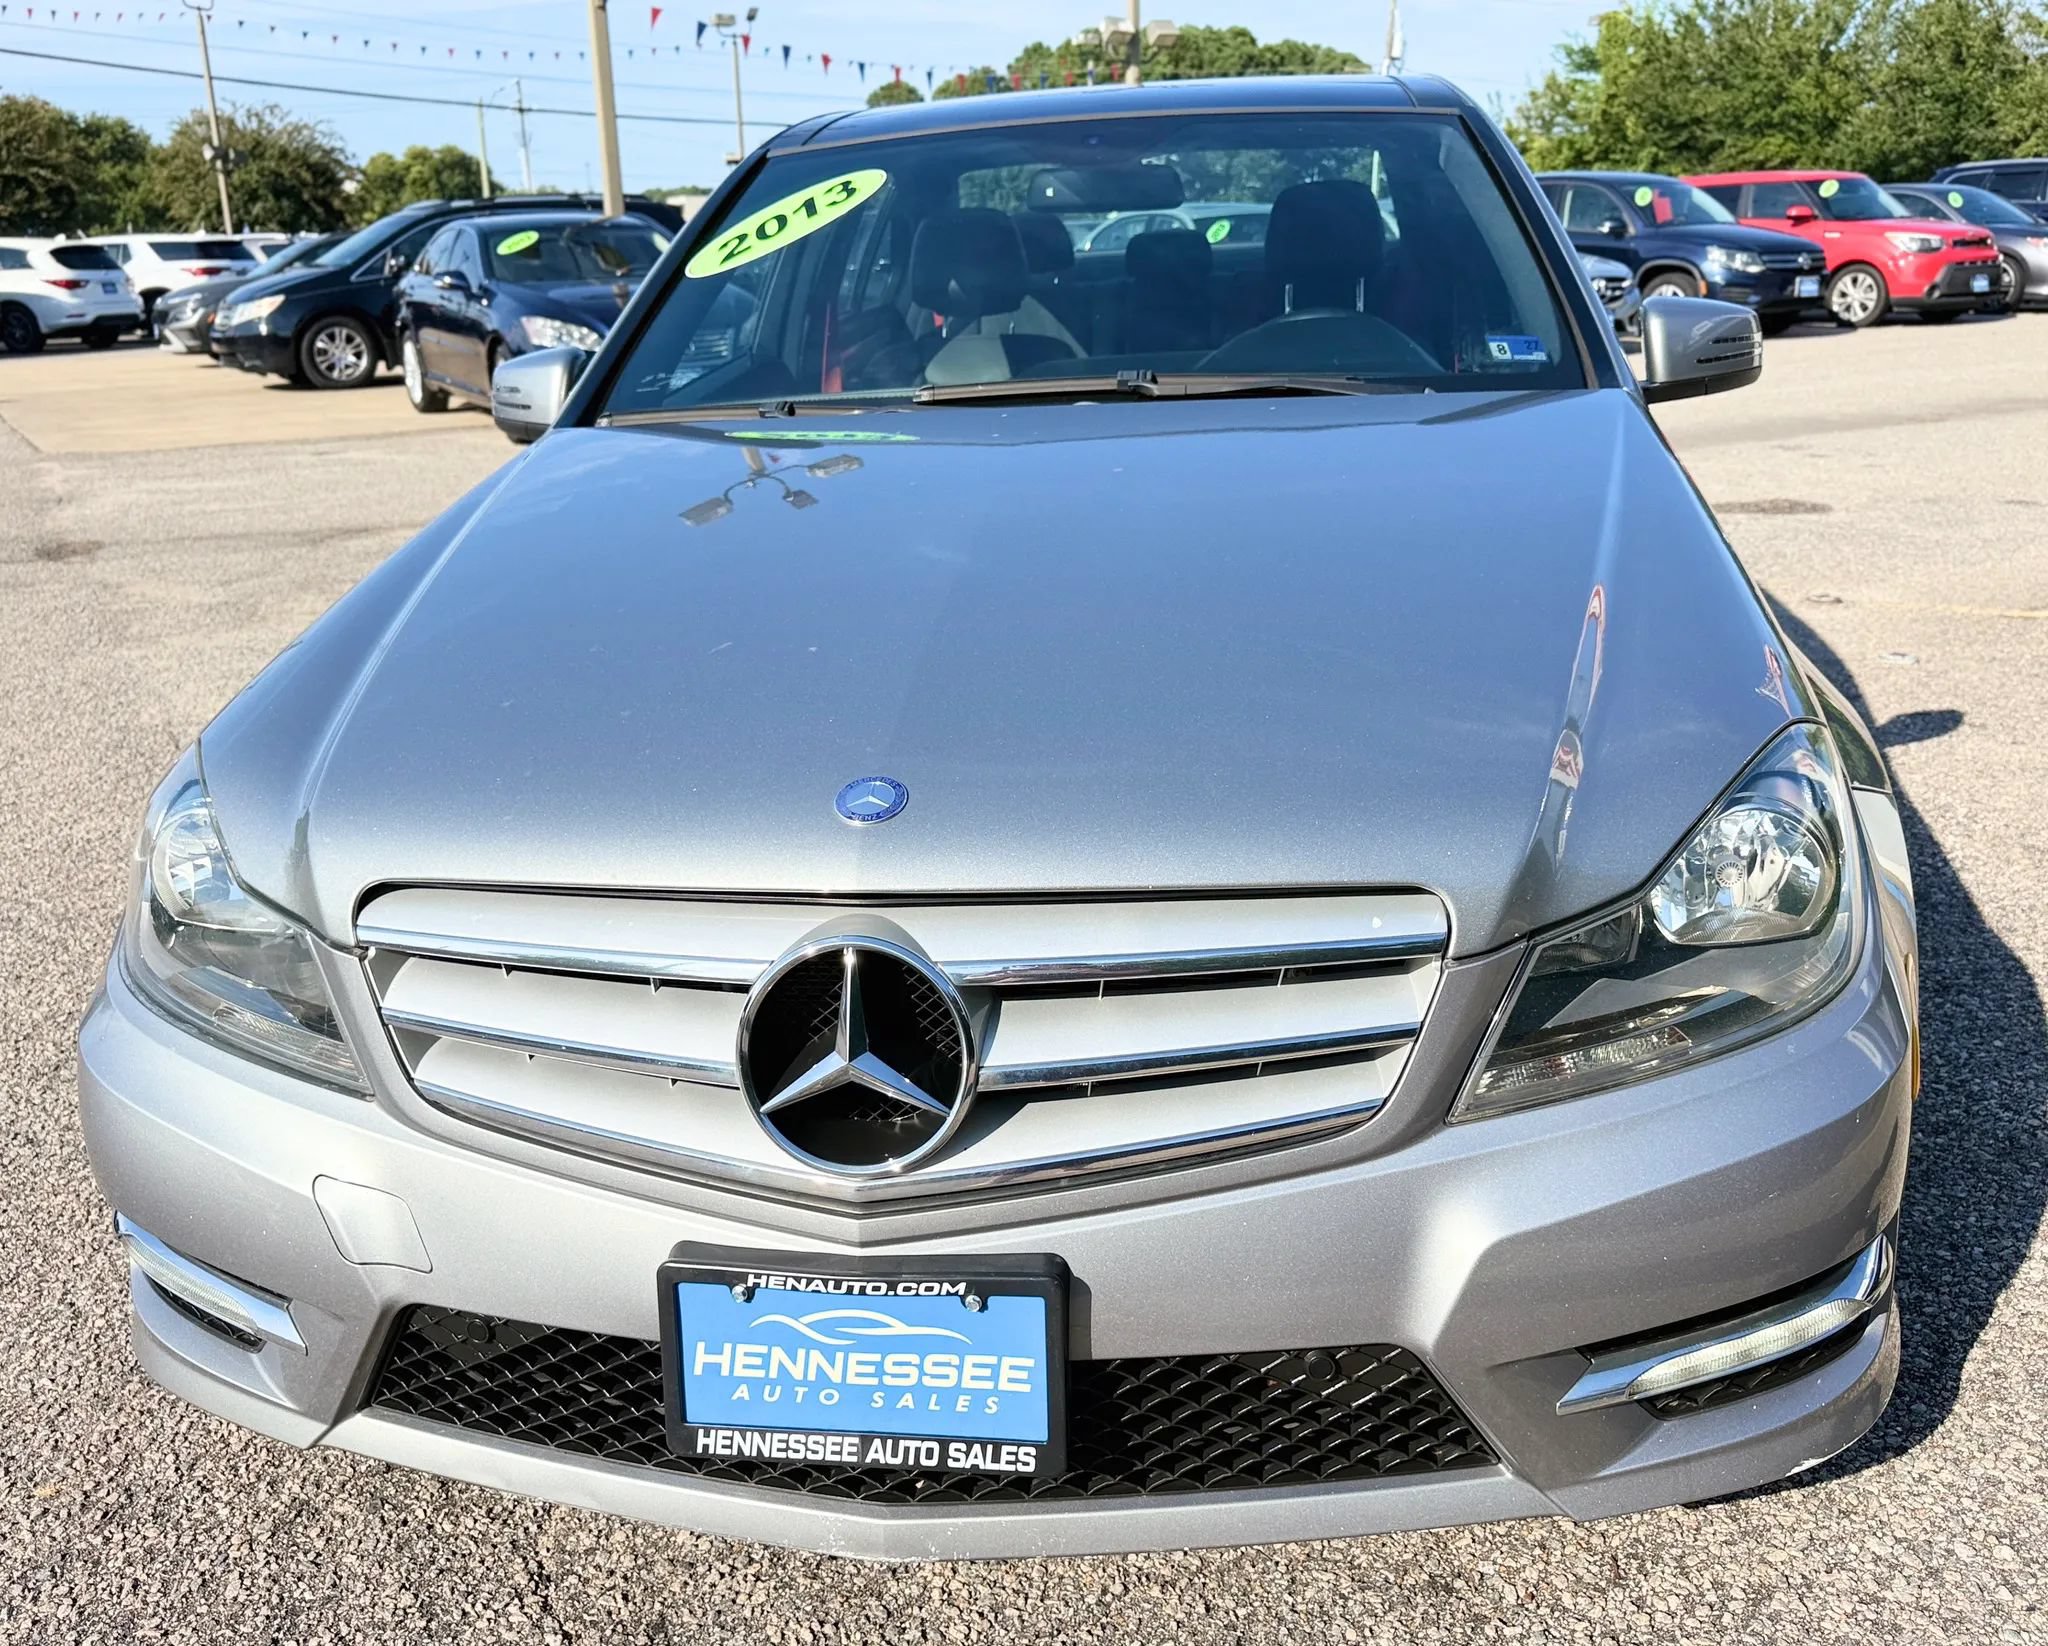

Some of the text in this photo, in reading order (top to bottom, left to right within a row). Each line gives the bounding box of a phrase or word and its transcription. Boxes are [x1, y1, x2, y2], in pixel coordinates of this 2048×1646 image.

[719, 180, 857, 265] 2013
[1496, 344, 1507, 355] 8
[746, 1273, 967, 1297] HENAUTO.COM
[693, 1341, 1036, 1393] HENNESSEE
[731, 1383, 1001, 1415] AUTO SALES
[696, 1428, 1037, 1473] HENNESSEE AUTO SALES
